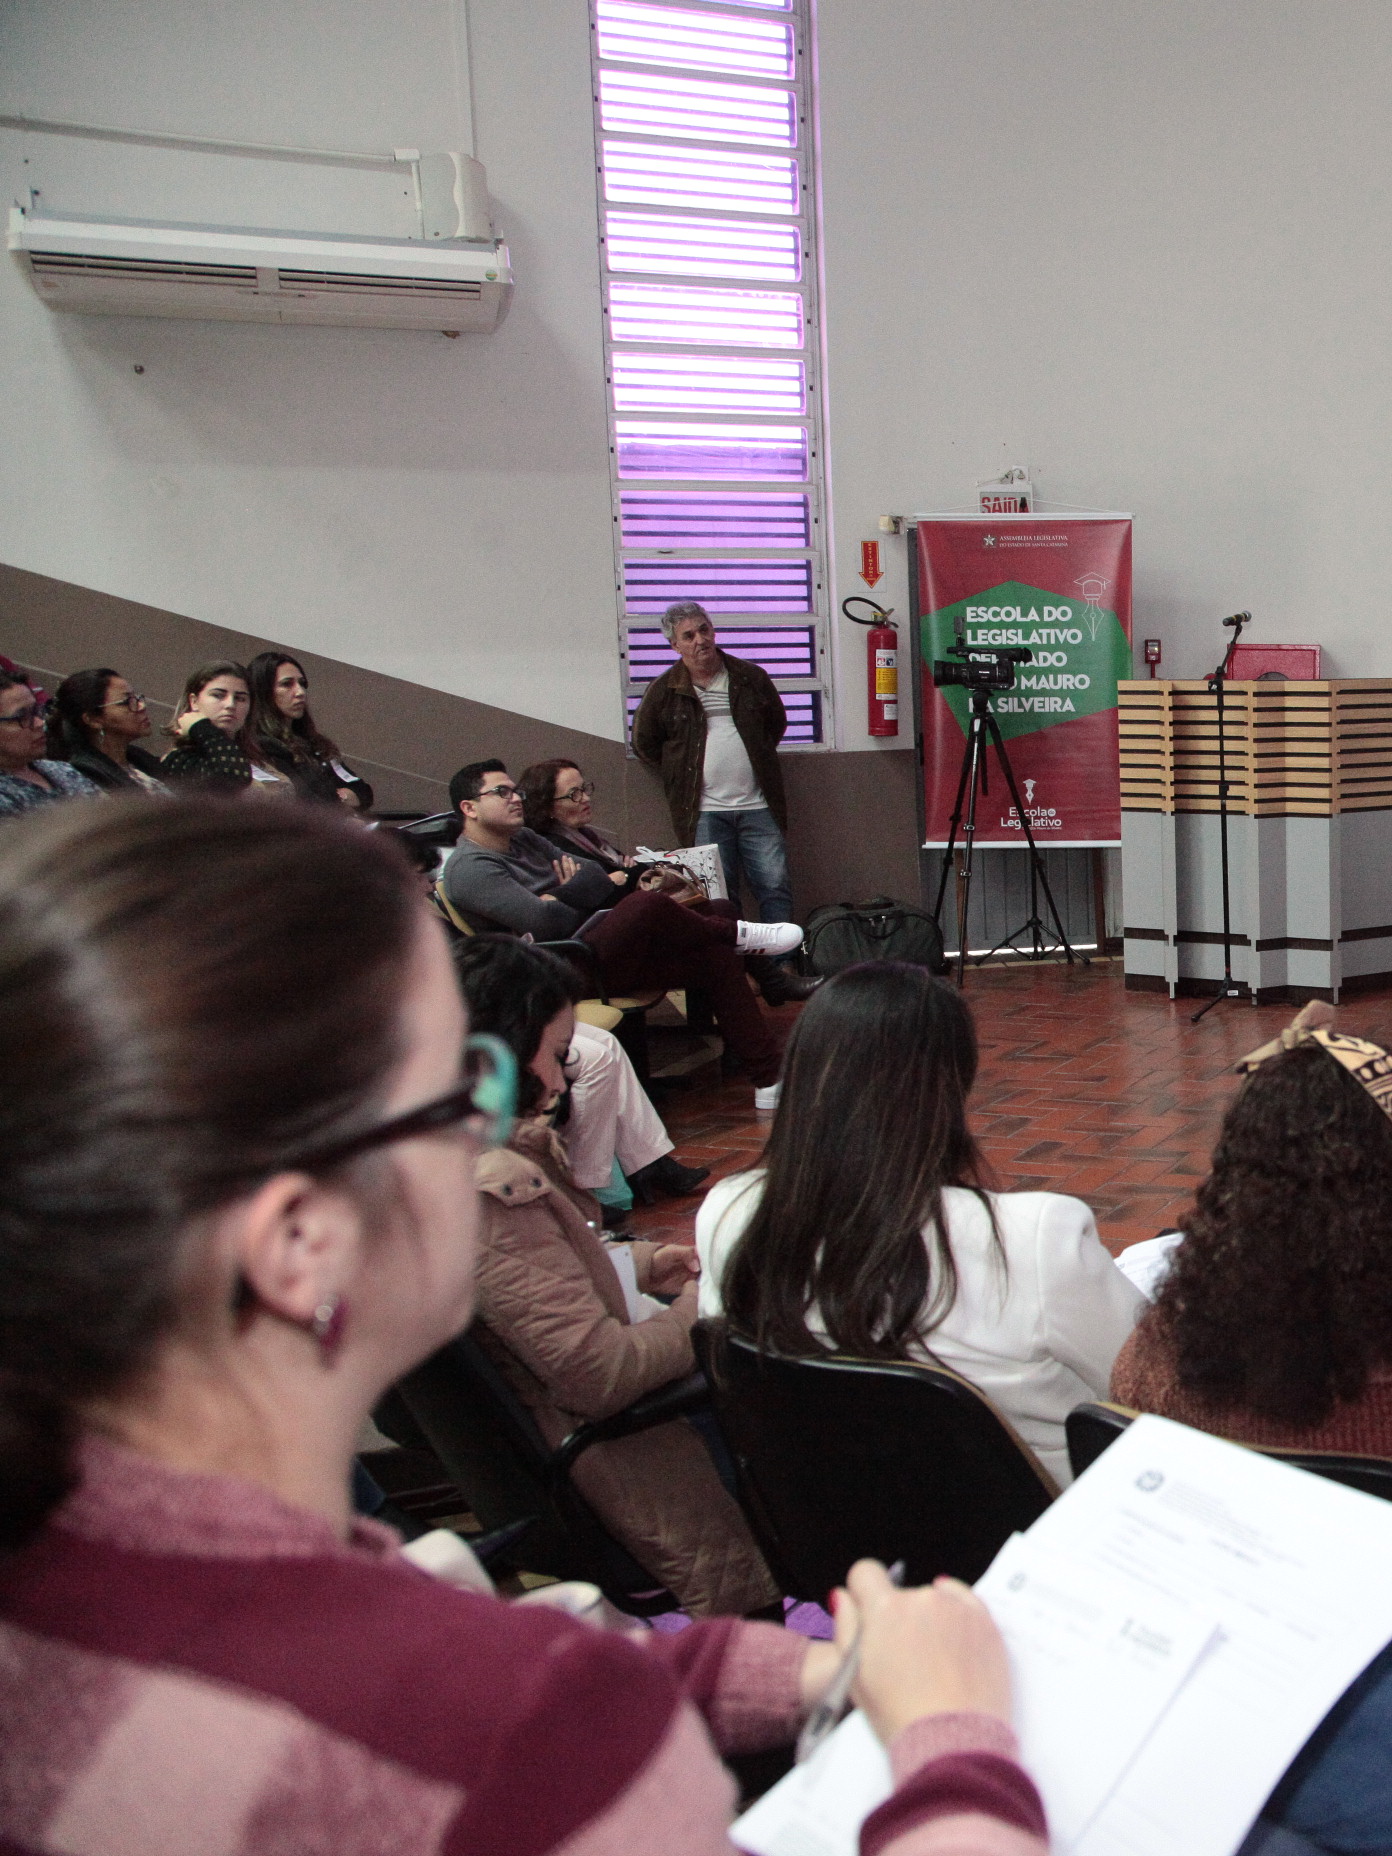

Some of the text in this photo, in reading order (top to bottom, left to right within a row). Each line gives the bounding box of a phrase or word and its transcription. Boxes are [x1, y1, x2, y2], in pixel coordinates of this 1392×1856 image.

[966, 606, 1072, 622] ESCOLA DO
[966, 629, 1082, 645] LEGISLATIVO
[968, 651, 1067, 667] DEADO
[1021, 674, 1090, 690] MAURO
[997, 697, 1075, 713] SILVEIRA
[1001, 816, 1062, 830] Leglativo
